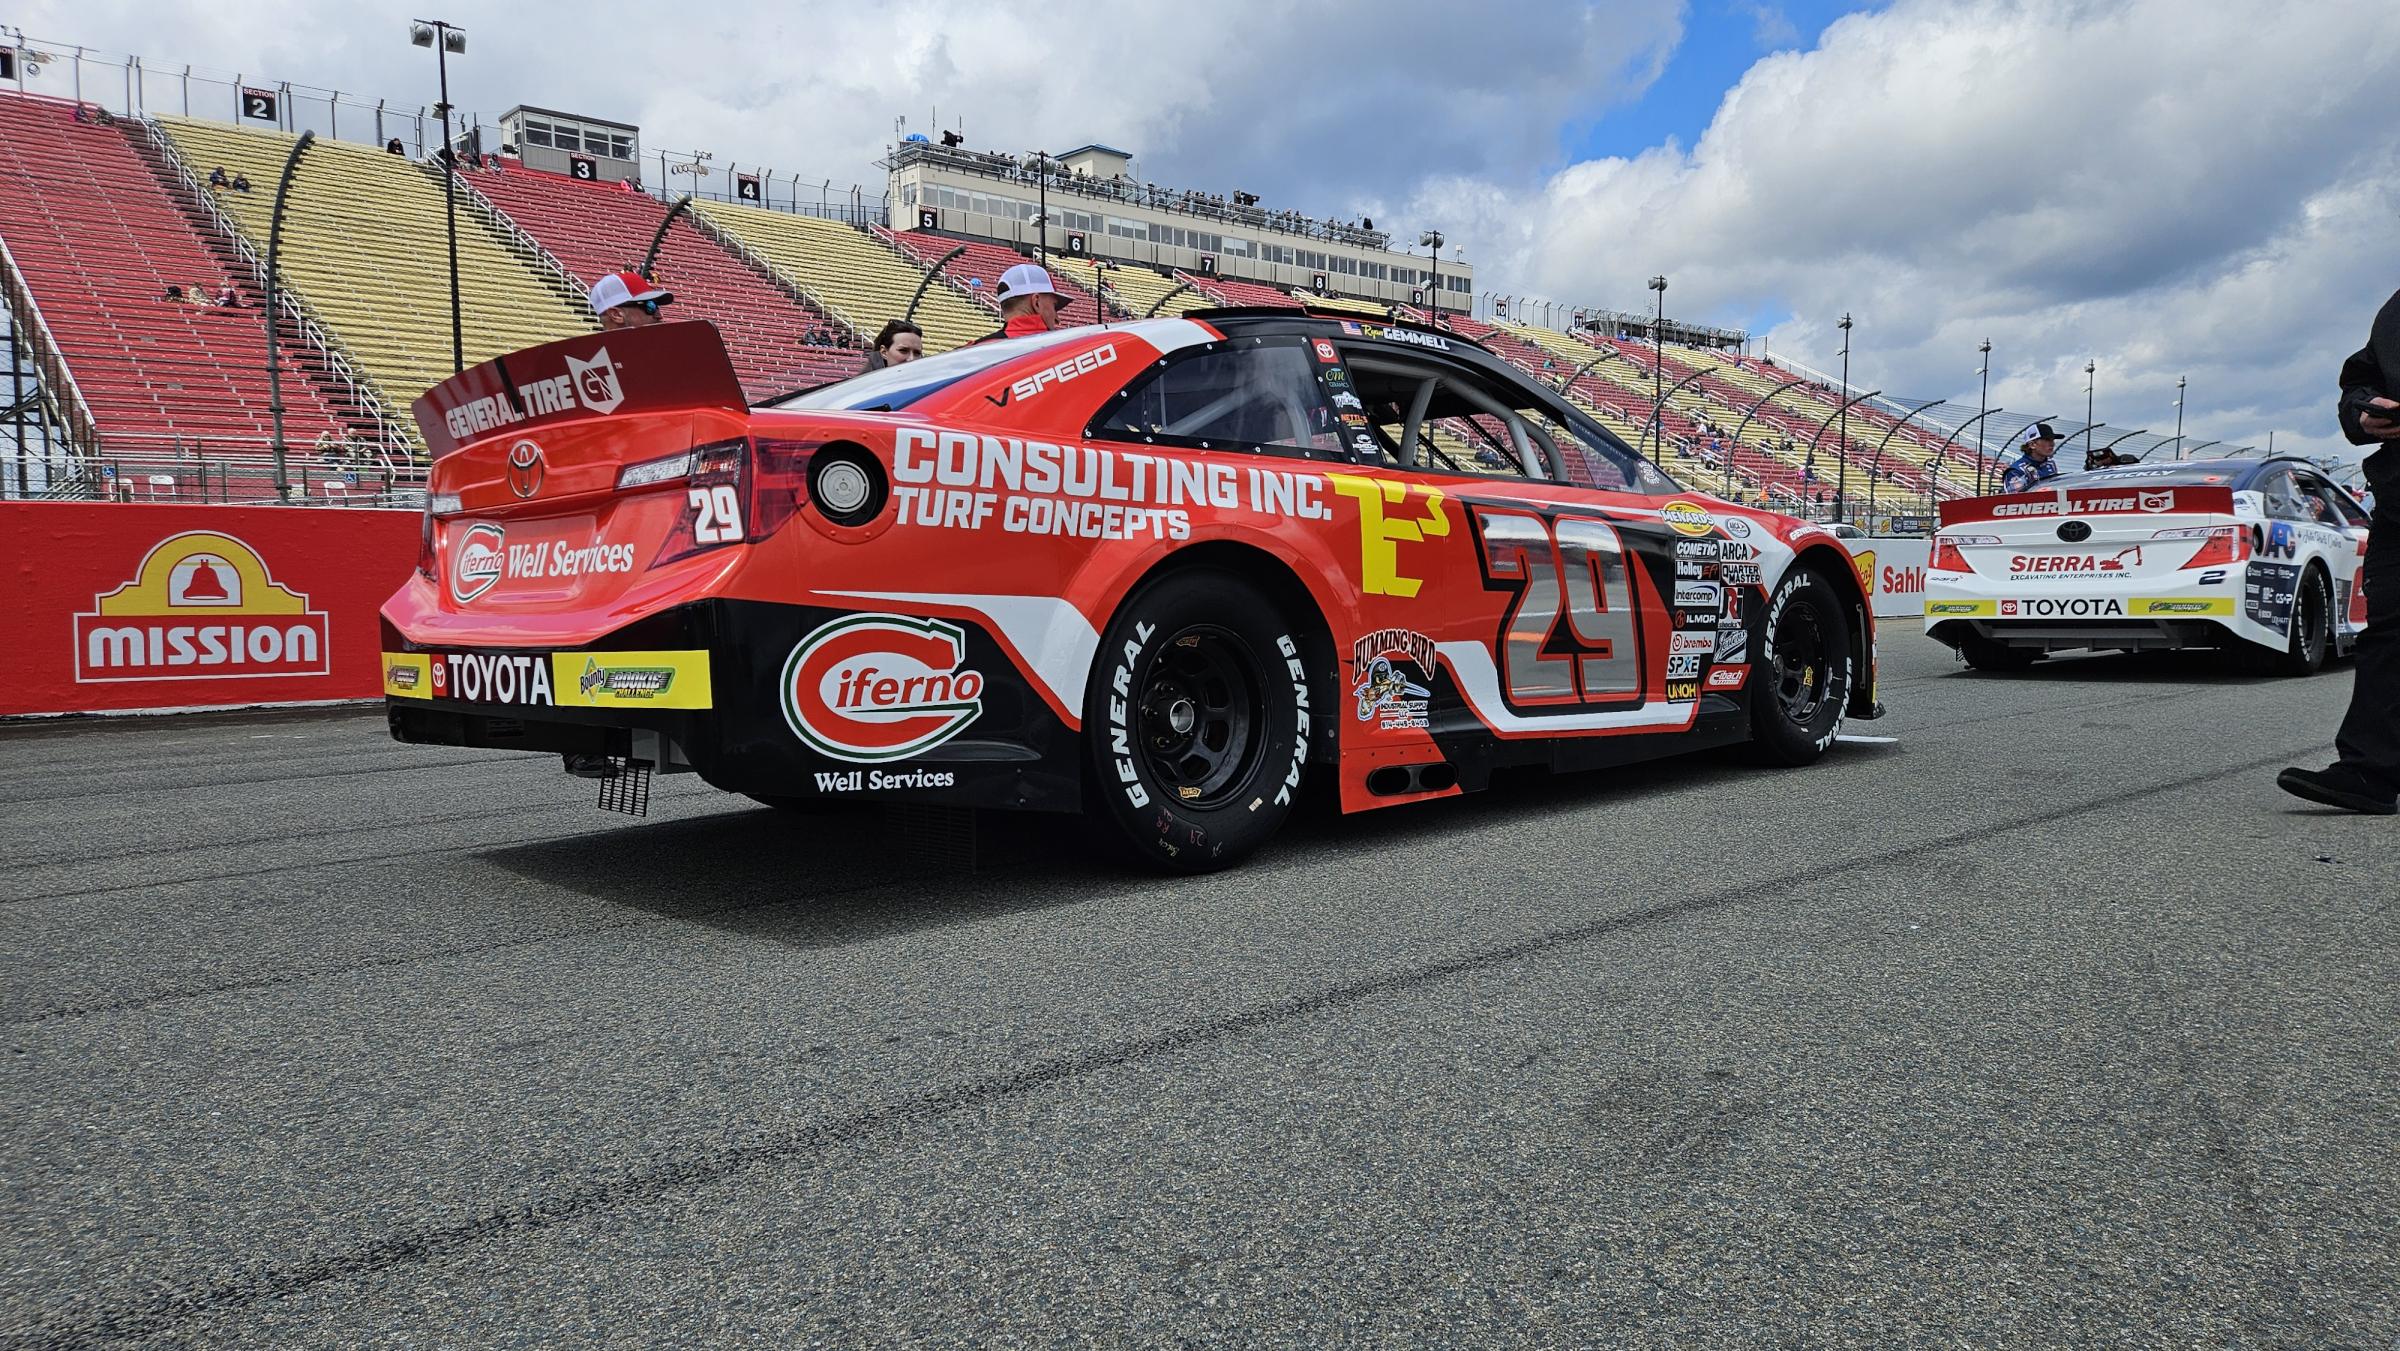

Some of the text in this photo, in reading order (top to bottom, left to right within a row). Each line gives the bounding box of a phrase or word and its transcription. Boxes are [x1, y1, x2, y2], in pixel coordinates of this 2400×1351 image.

[243, 88, 275, 98] SECTION
[252, 98, 268, 118] 2
[570, 152, 596, 161] SECTION
[577, 161, 590, 179] 3
[743, 182, 755, 198] 4
[923, 213, 933, 228] 5
[1071, 237, 1081, 252] 6
[1203, 259, 1212, 272] 7
[1316, 277, 1324, 289] 8
[1415, 292, 1422, 304] 9
[1496, 305, 1506, 316] 10
[1361, 324, 1450, 351] Ryan GEMMELL
[518, 374, 577, 418] TIRE
[892, 427, 1333, 521] CONSULTING INC.
[2090, 469, 2177, 481] STECKLY
[893, 485, 1191, 541] TURF CONCEPTS
[2086, 497, 2137, 512] TIRE
[688, 483, 746, 545] 29
[1660, 509, 1716, 527] MENARDS
[506, 541, 549, 579] Well
[548, 535, 635, 578] Services
[1676, 540, 1718, 557] COMETIC
[1721, 542, 1748, 561] ARCA
[1676, 560, 1703, 579] Holley
[1722, 564, 1759, 578] QUARTER
[2009, 555, 2096, 573] SIERRA
[1728, 573, 1761, 585] MASTER
[2009, 573, 2057, 581] EXCAVATING
[2057, 572, 2113, 580] ENTERPRISES
[2197, 570, 2227, 585] 2
[1470, 503, 1643, 706] 29
[1675, 589, 1713, 604] Intercomp
[2020, 598, 2123, 616] TOYOTA
[1686, 614, 1717, 624] ILMOR
[1764, 572, 1812, 661] GENERAL
[1683, 636, 1713, 649] brembo
[1352, 629, 1437, 686] HUMMING BIRD
[447, 653, 554, 706] TOYOTA
[580, 666, 662, 696] Bounty ROOKIE
[1709, 669, 1744, 685] Eibach
[614, 687, 655, 699] CHALLENGE
[1667, 683, 1697, 699] UNOH
[1110, 620, 1156, 809] GENERAL
[1276, 633, 1311, 807] GENERAL
[813, 768, 955, 793] Well Services
